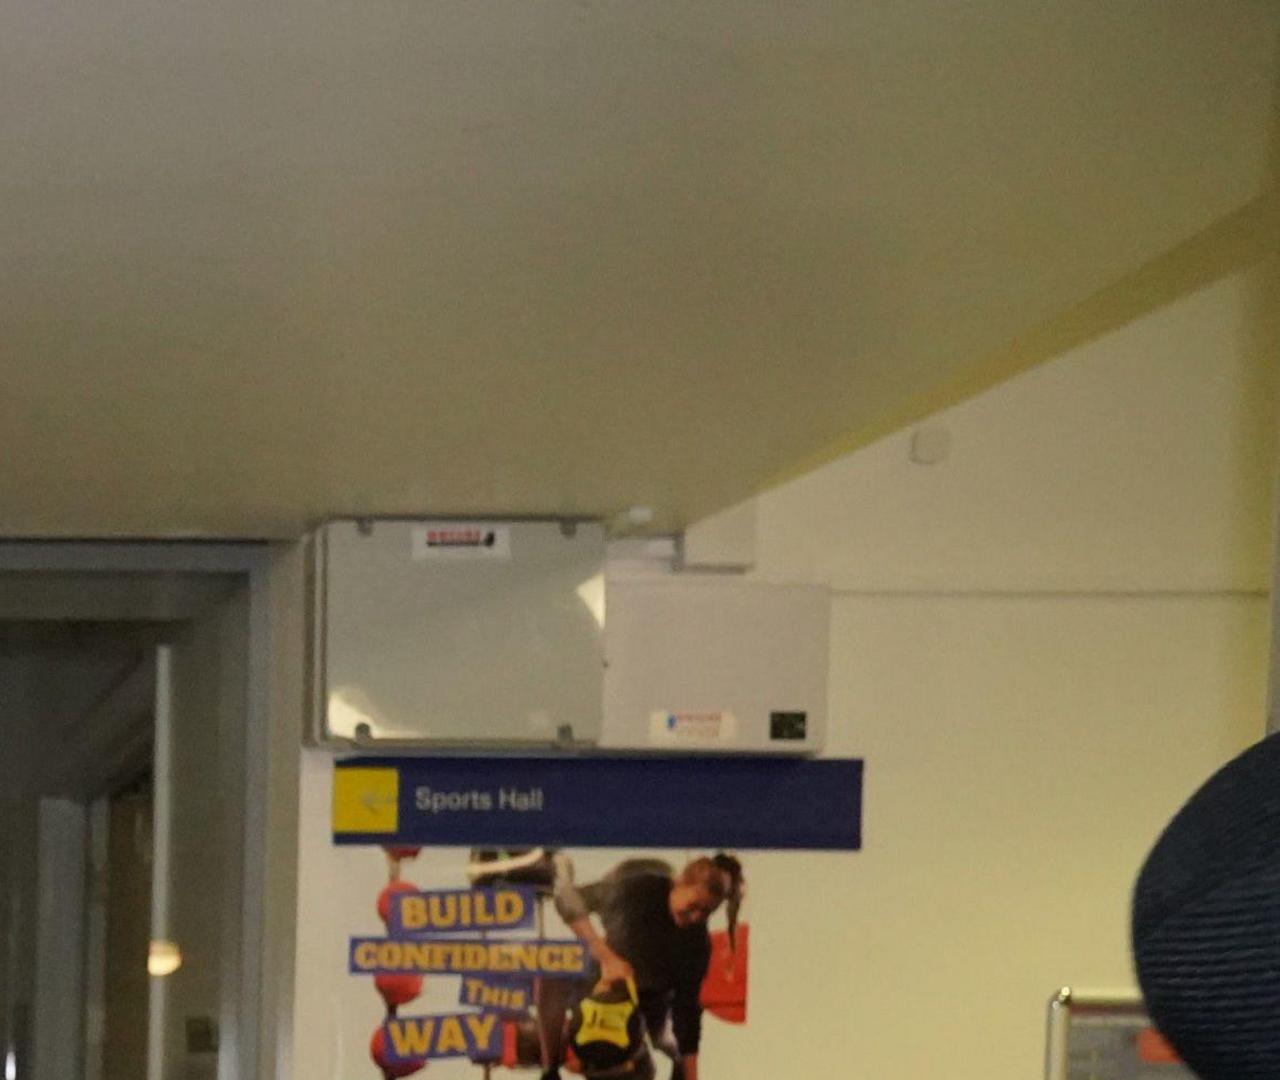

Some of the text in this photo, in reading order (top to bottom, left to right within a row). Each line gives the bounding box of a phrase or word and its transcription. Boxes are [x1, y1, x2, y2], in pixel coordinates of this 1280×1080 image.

[415, 785, 544, 814] Sports Hall
[400, 891, 524, 929] BUILD
[354, 942, 584, 972] CONFIDENCE
[390, 1012, 497, 1057] WAY
